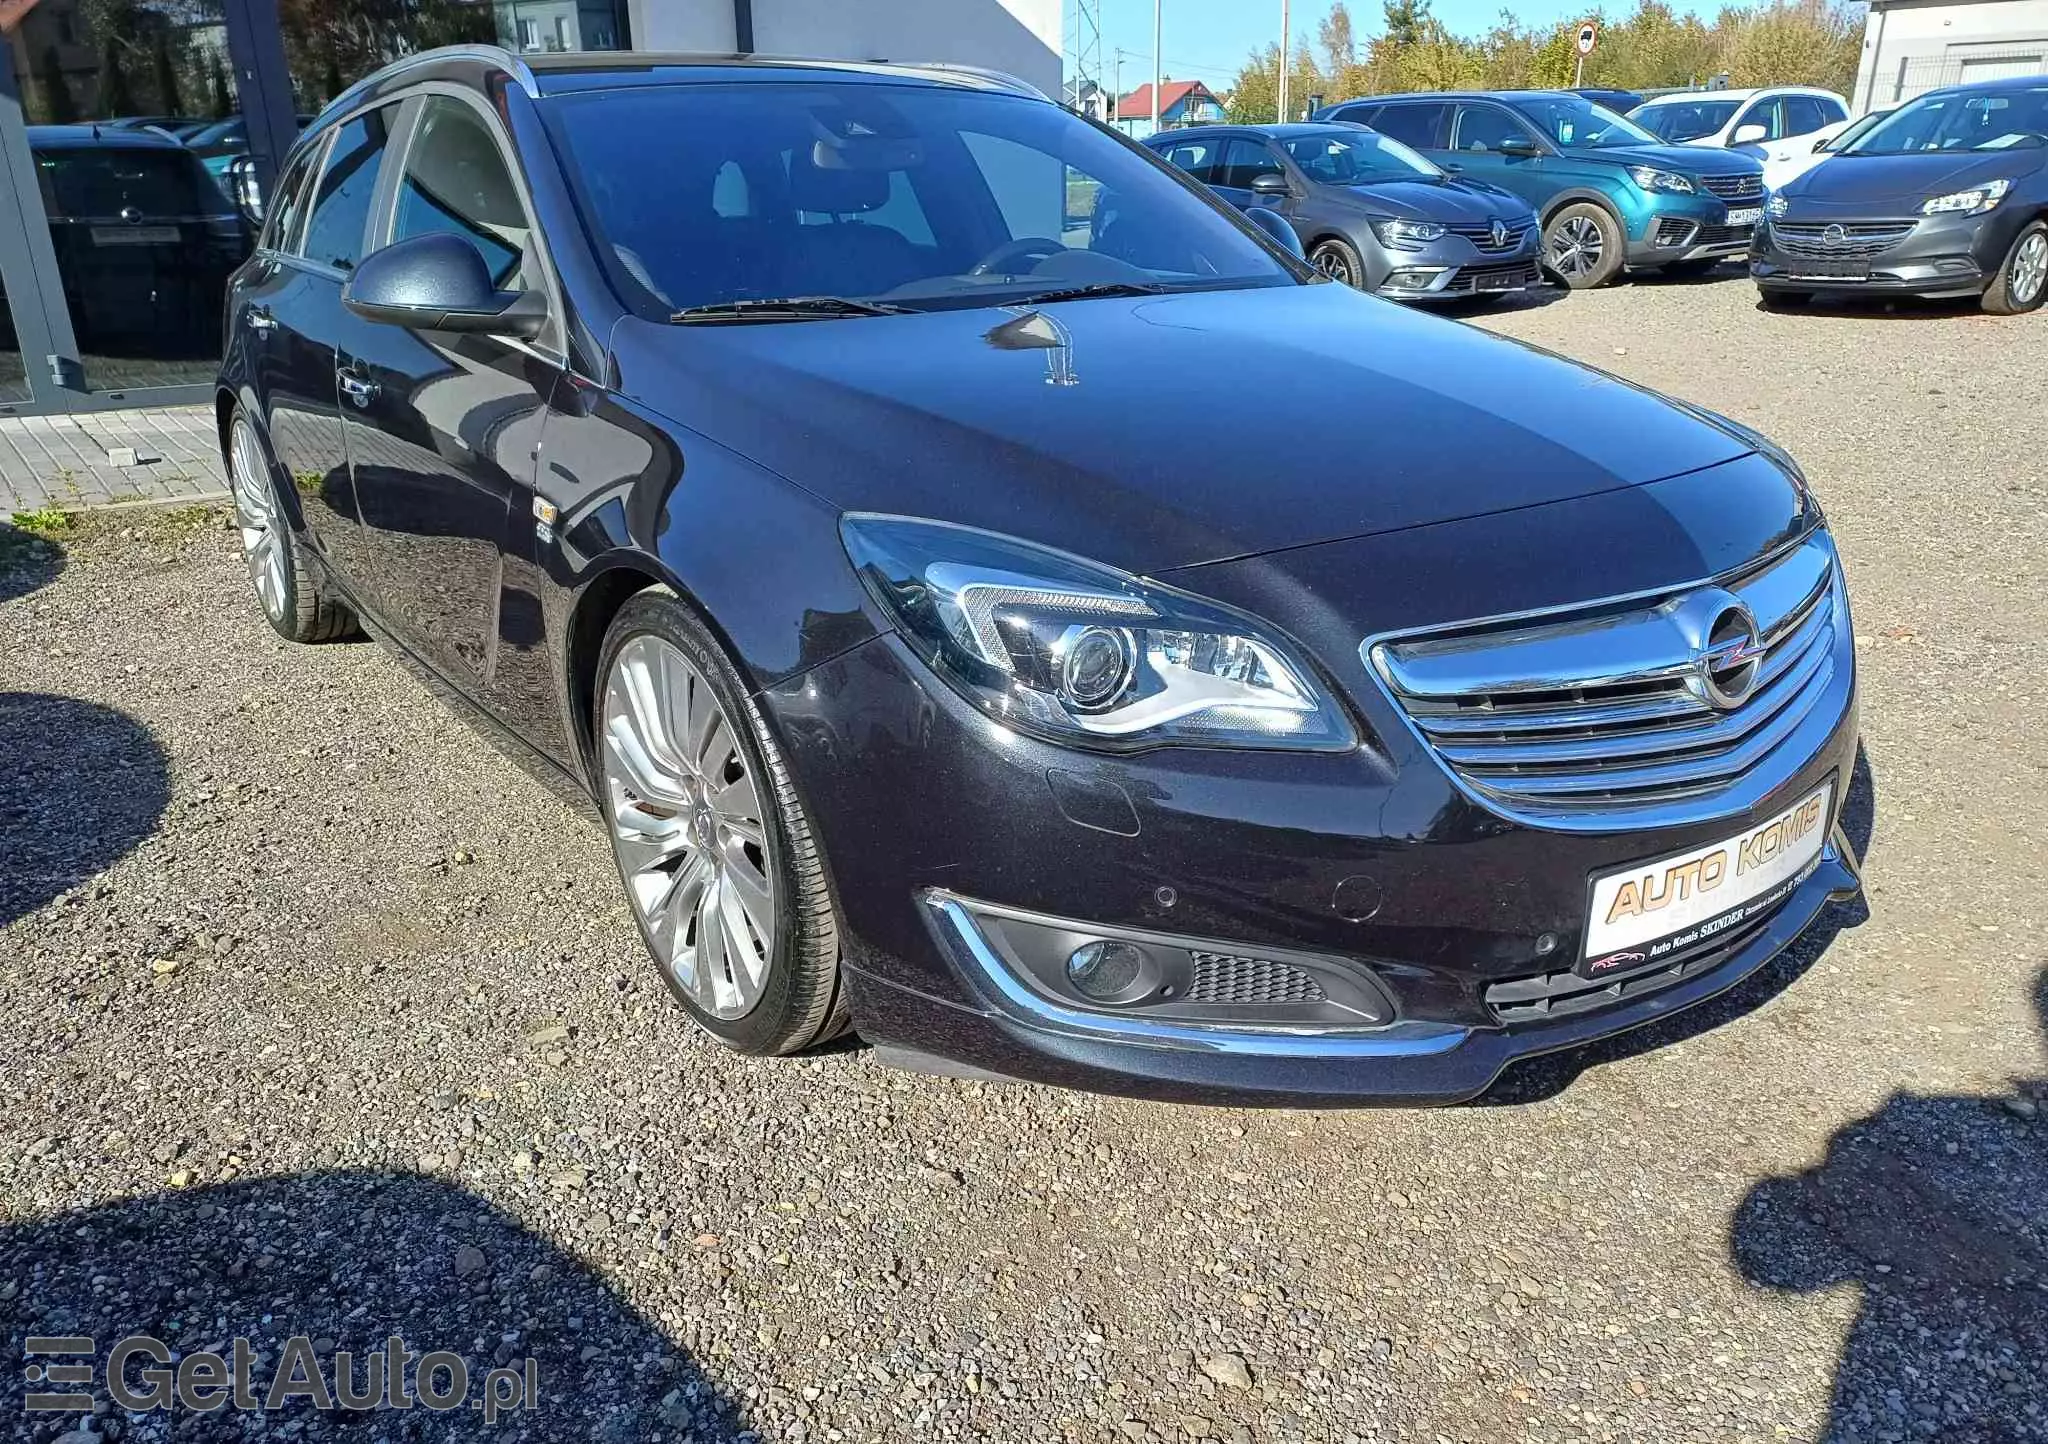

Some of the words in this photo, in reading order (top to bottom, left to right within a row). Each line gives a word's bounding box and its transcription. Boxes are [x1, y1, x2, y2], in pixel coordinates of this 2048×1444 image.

[1605, 848, 1728, 926] AUTO
[1736, 792, 1823, 877] KOMIS
[1650, 942, 1671, 957] Auto
[1673, 930, 1699, 949] Komis
[1699, 908, 1745, 938] SKINDER
